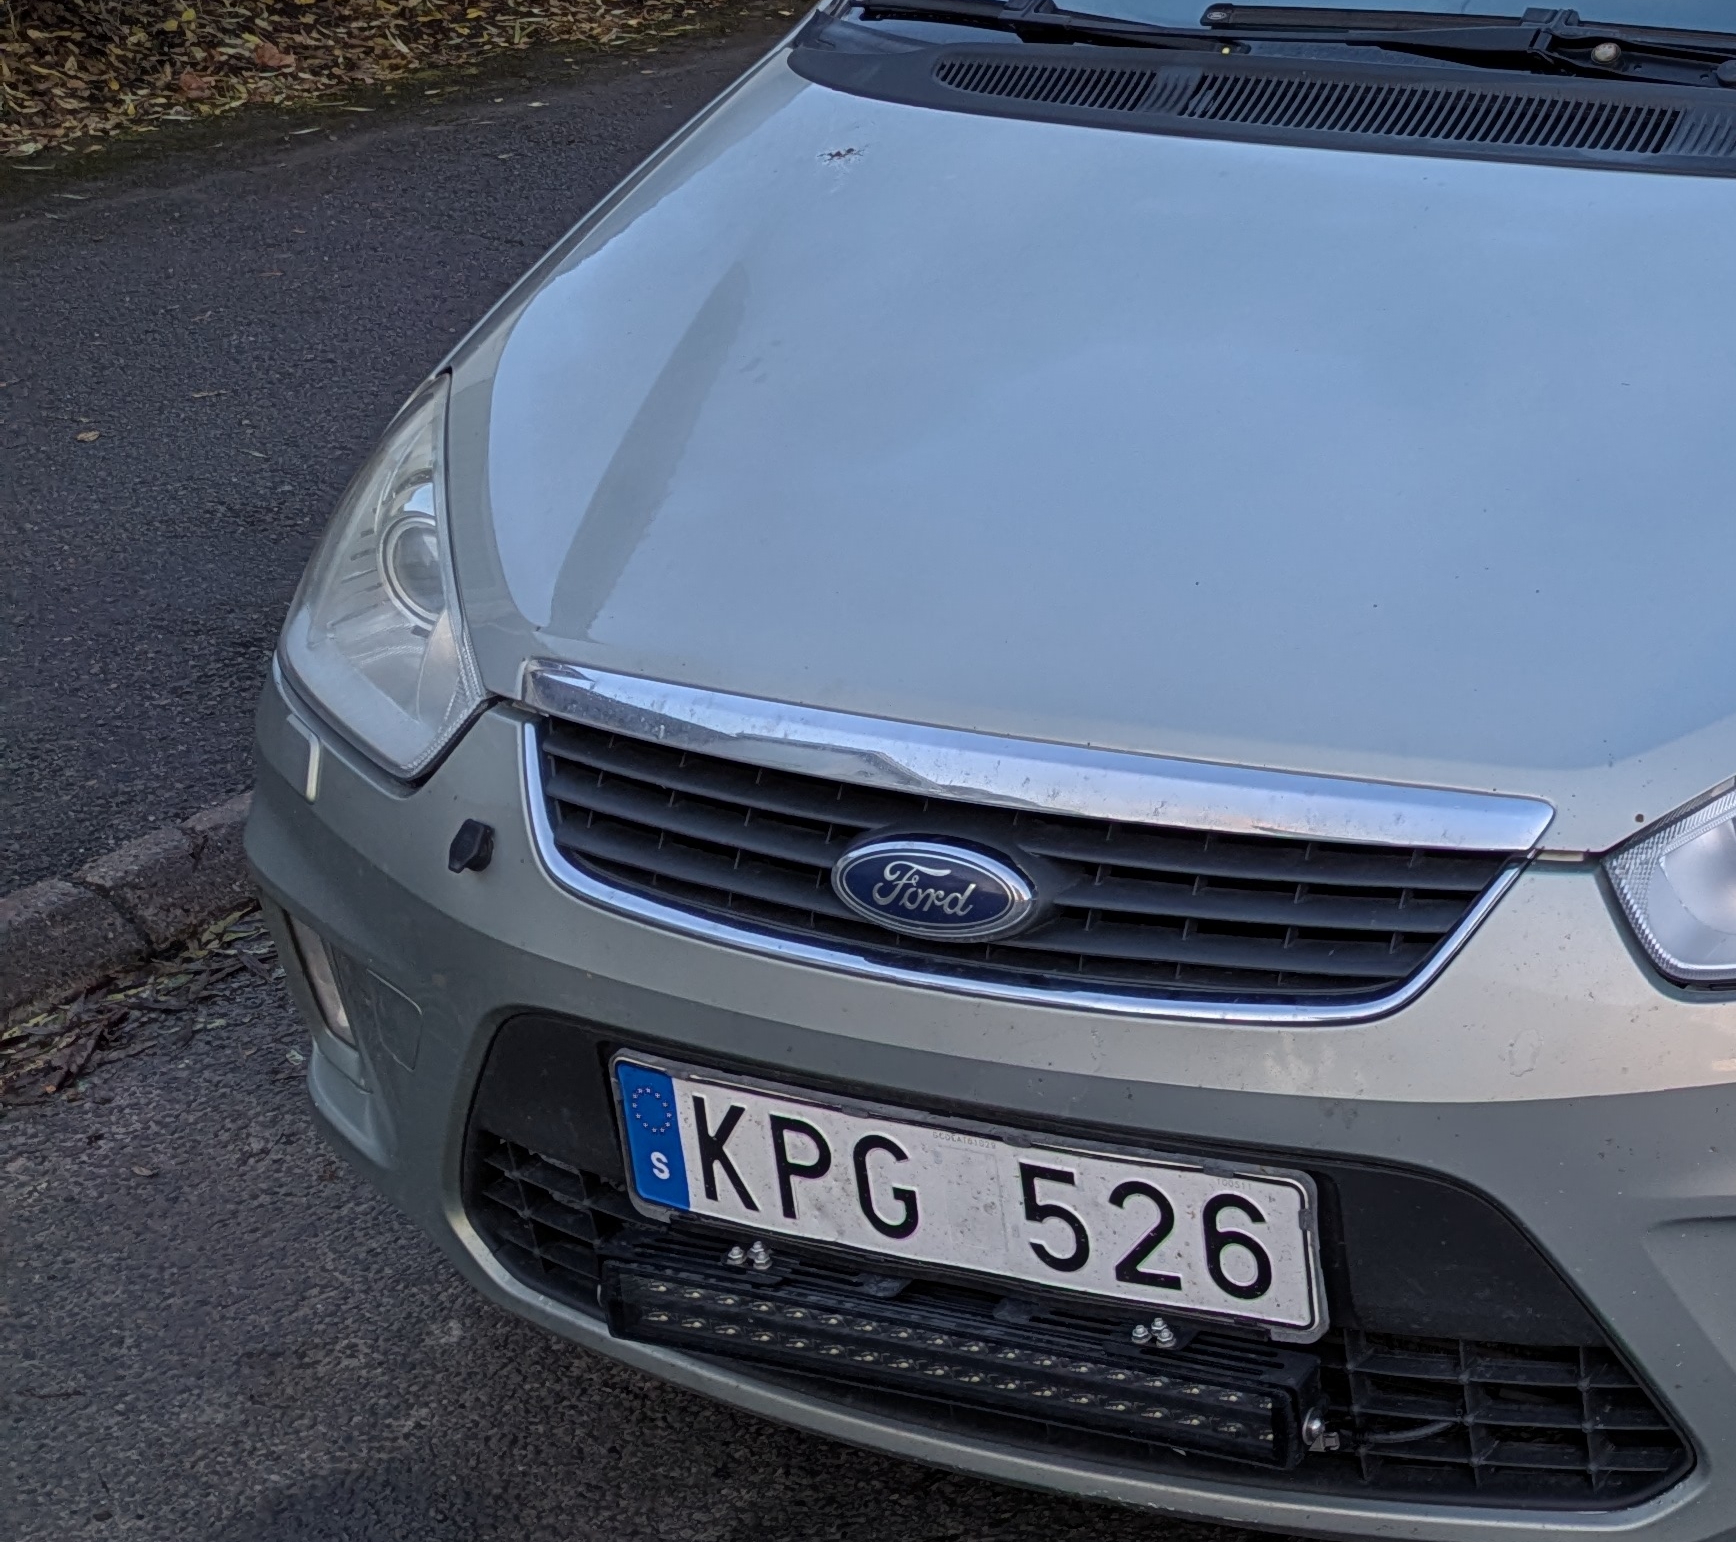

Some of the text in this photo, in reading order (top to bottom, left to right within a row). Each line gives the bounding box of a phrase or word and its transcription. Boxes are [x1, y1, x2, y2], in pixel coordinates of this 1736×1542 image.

[872, 860, 976, 917] Ford
[652, 1151, 669, 1181] S
[692, 1094, 1273, 1301] KPG 526
